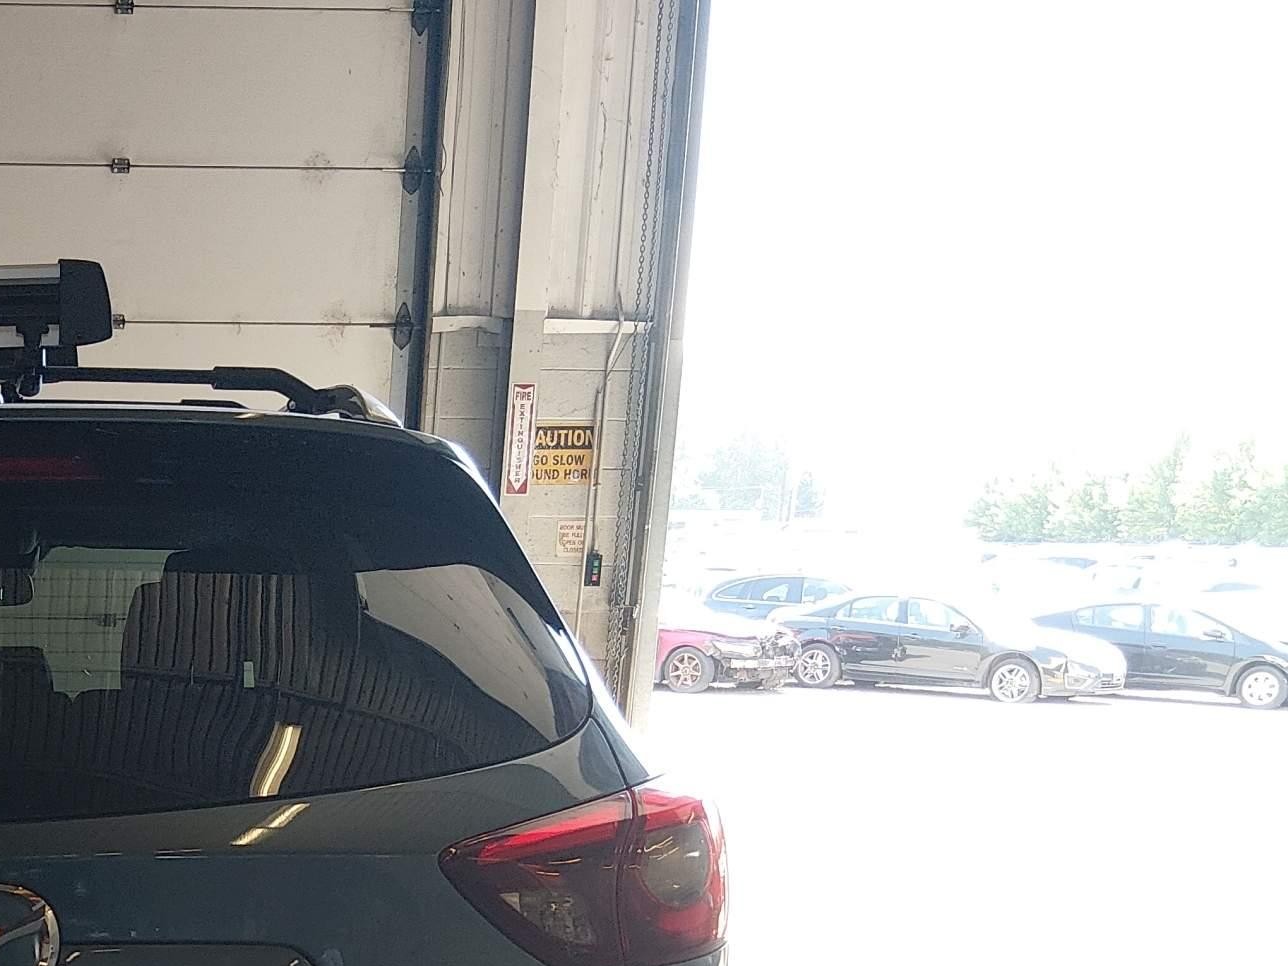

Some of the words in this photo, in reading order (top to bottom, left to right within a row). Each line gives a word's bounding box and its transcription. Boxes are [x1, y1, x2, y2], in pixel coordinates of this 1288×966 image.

[515, 391, 532, 401] FIRE
[514, 403, 525, 483] EXTINGUISHER
[535, 429, 593, 447] AUTION
[552, 454, 585, 466] SLOW
